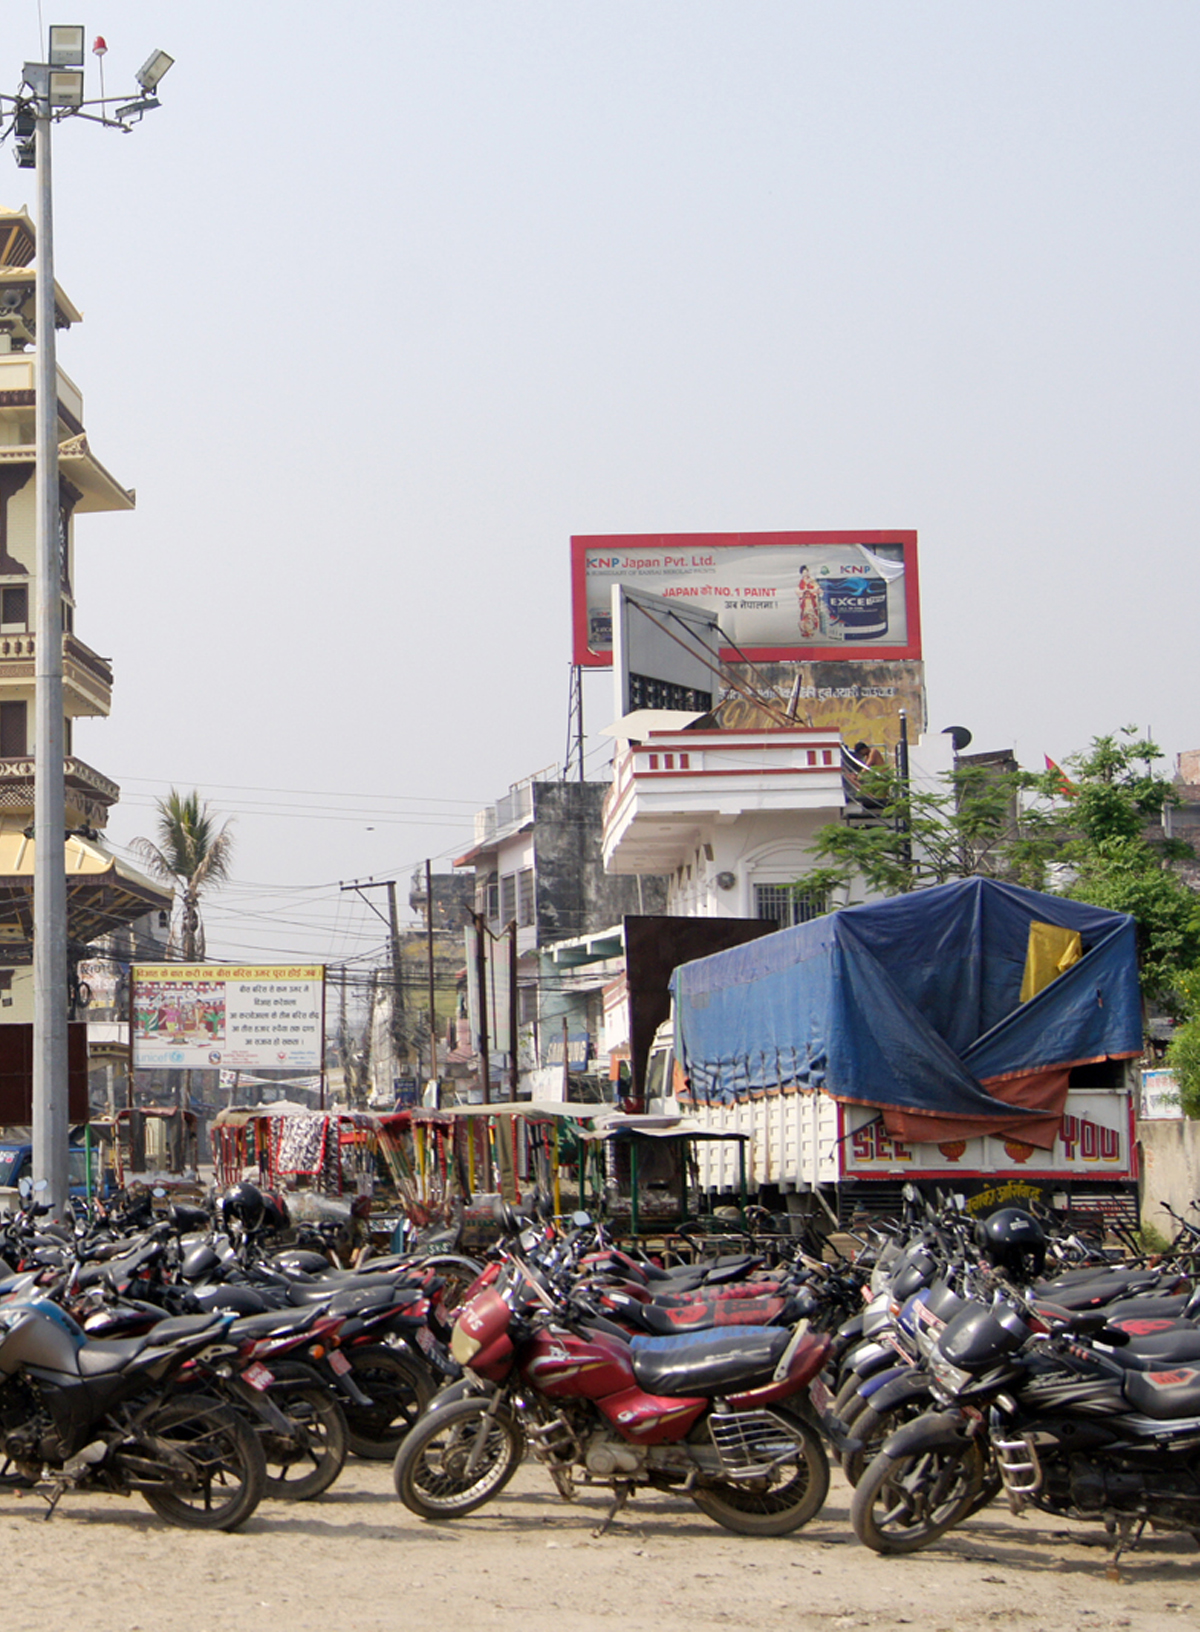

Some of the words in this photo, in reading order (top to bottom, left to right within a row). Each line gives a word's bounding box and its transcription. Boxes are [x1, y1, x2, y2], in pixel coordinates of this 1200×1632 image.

[586, 558, 620, 568] KNP
[621, 558, 660, 570] Japan
[664, 556, 688, 567] Pvt.
[692, 555, 716, 566] Ltd.
[840, 565, 871, 574] KNP
[662, 587, 699, 597] JAPAN
[744, 588, 777, 597] PAINT
[137, 1051, 168, 1062] unicef
[1059, 1114, 1120, 1162] YOU
